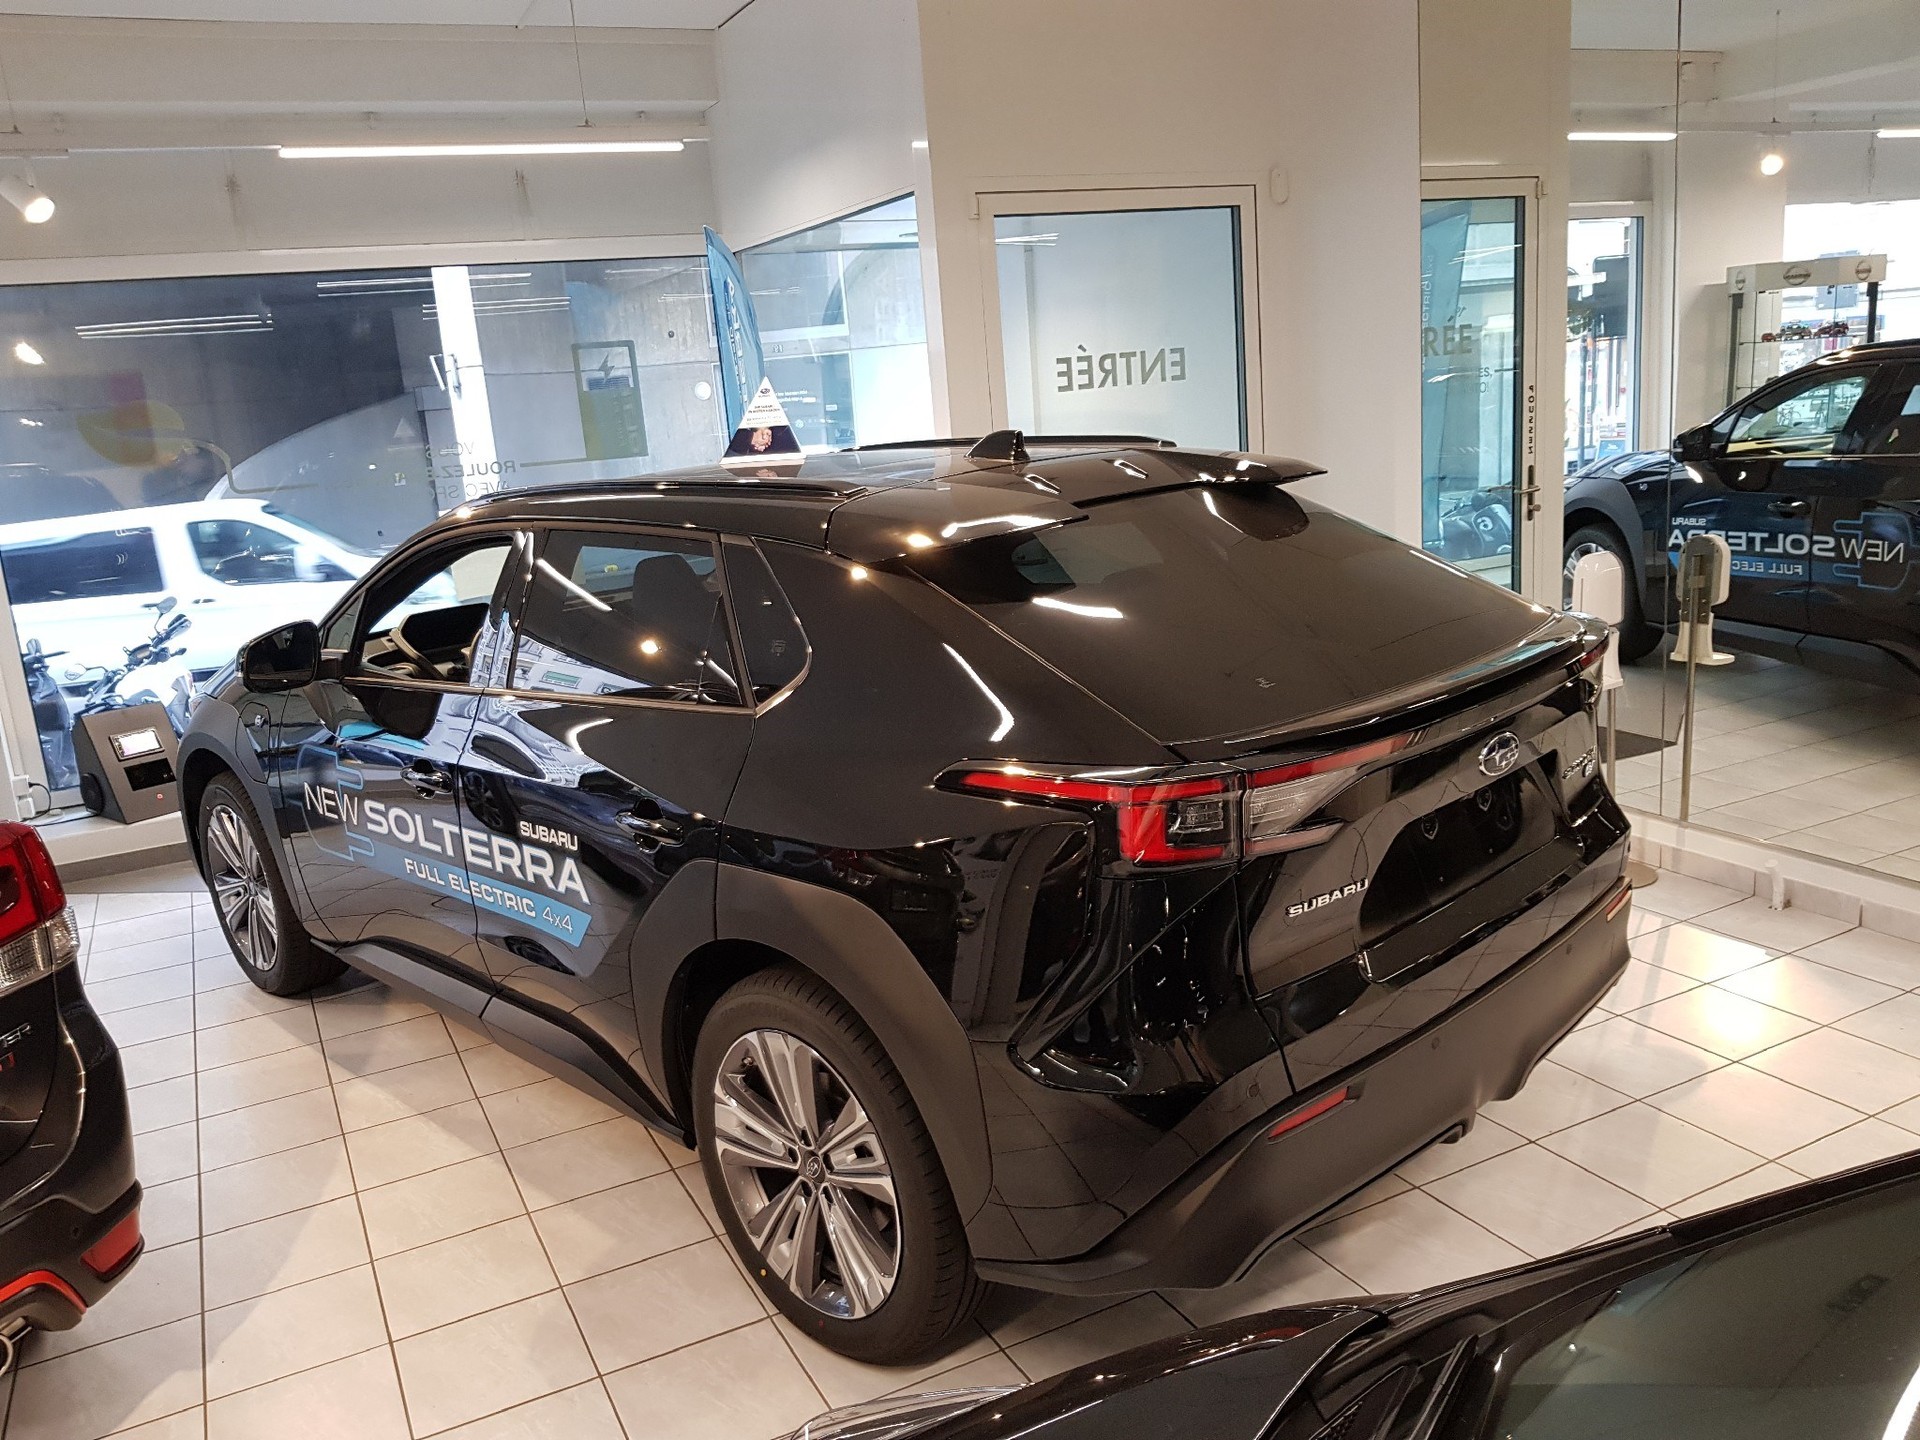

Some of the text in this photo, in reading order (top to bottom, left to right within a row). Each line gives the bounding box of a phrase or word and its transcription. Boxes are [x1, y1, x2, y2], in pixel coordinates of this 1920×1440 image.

[303, 782, 591, 905] NEW SOLTERRA
[519, 820, 579, 851] SUBARU
[403, 857, 574, 934] FULL ELECTRIC 4x4
[1286, 877, 1370, 918] SUBARU
